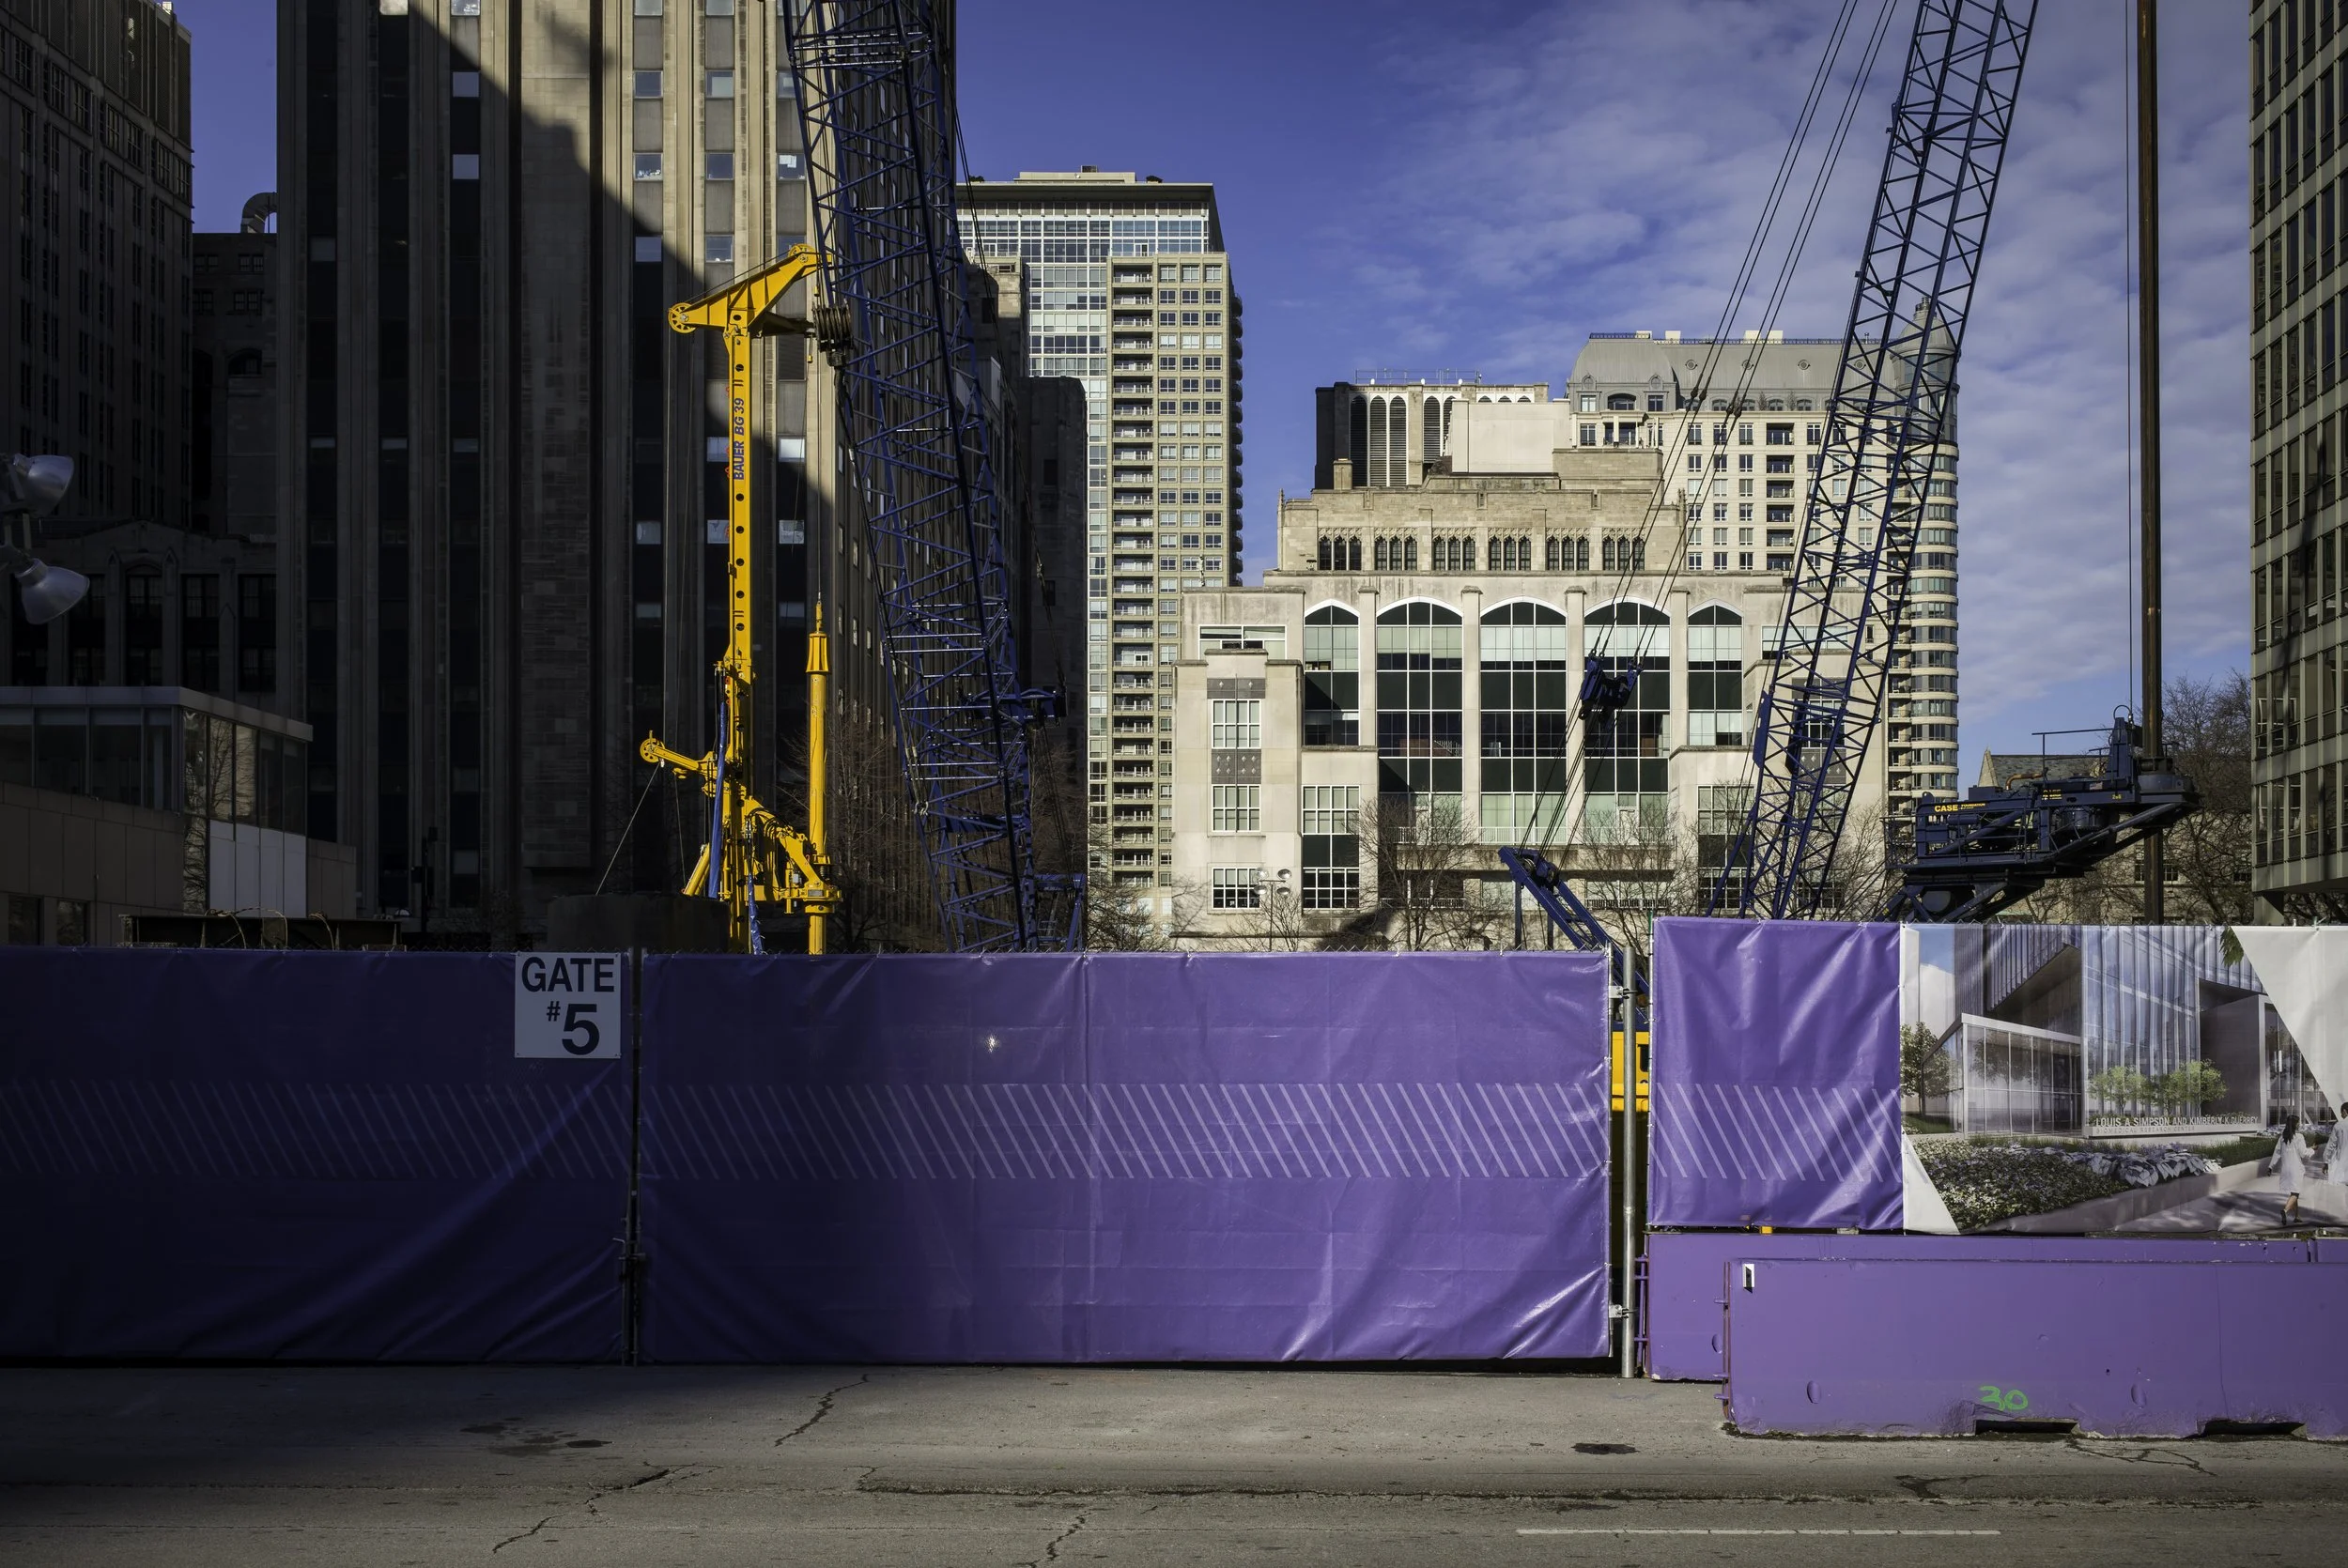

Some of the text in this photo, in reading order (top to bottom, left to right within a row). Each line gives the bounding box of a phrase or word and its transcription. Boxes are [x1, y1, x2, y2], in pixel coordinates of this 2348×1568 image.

[734, 397, 745, 480] BAUER BG 39
[521, 956, 615, 992] GATE
[546, 1000, 600, 1055] #5
[2095, 1117, 2122, 1127] LOUIS
[2124, 1117, 2131, 1127] A
[2134, 1116, 2170, 1127] SIMPSON
[2172, 1116, 2187, 1126] AND
[2189, 1116, 2222, 1126] KIMBERLY
[1979, 1385, 2029, 1412] 30
